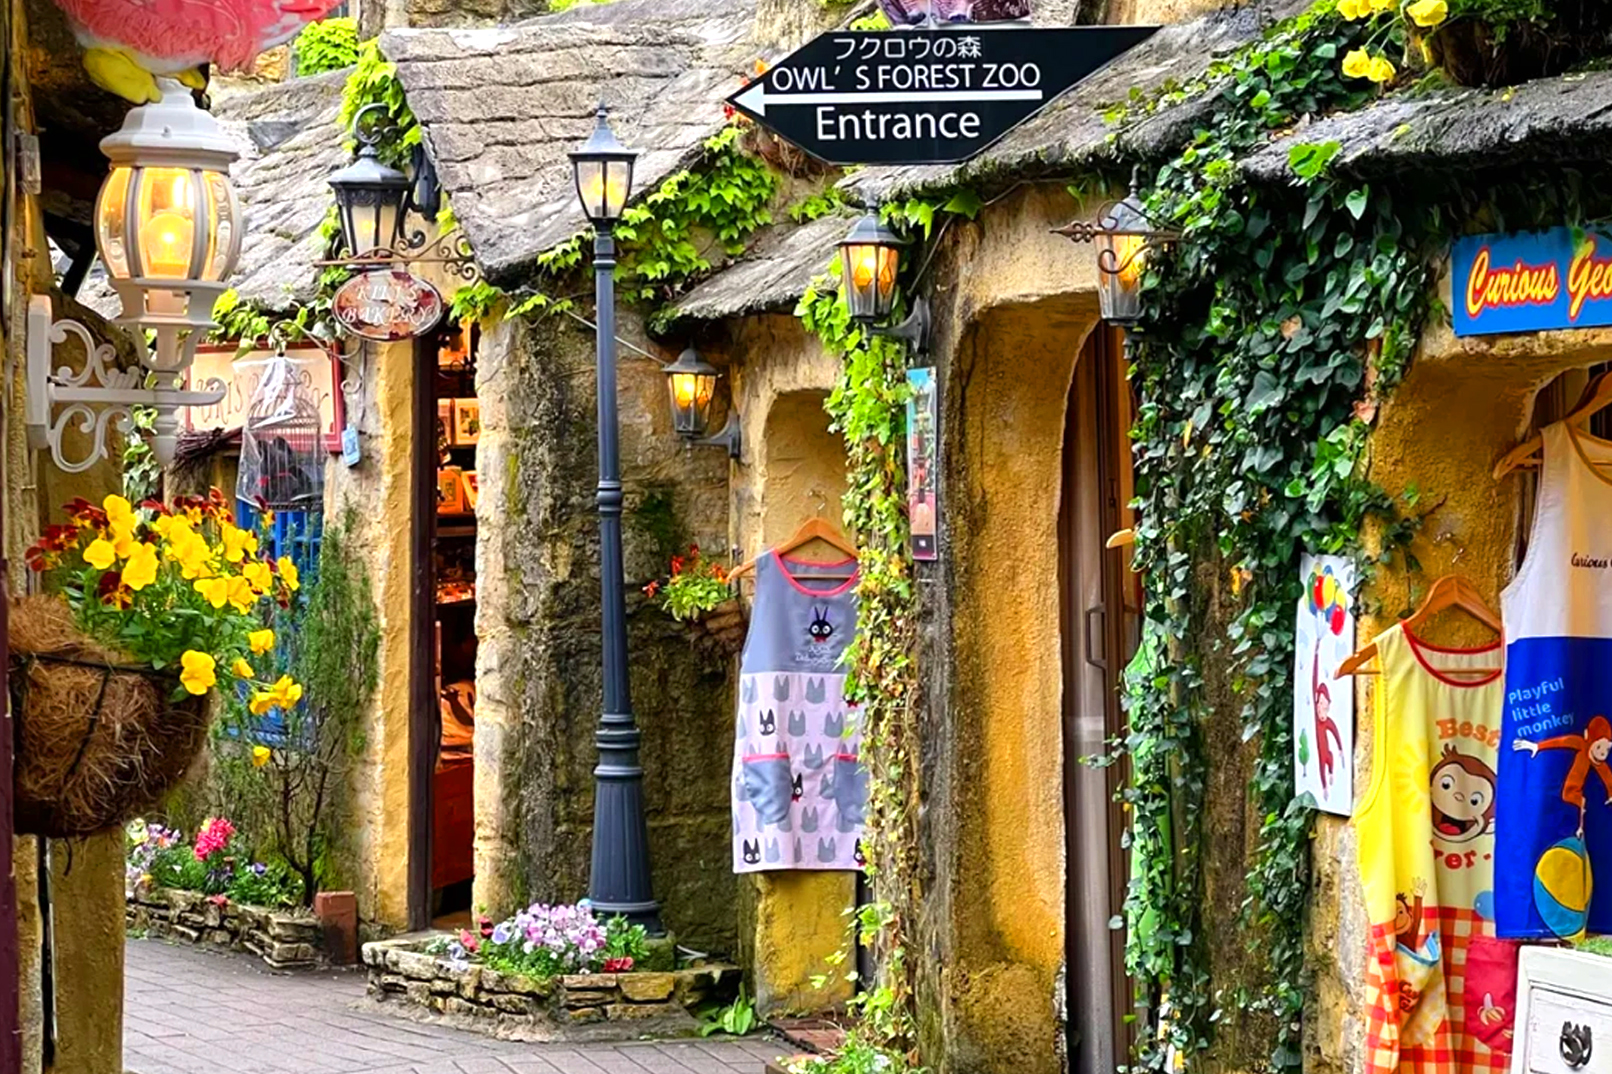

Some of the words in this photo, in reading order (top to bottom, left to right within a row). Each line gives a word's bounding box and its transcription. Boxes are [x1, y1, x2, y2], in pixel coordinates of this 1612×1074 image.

[833, 36, 982, 59] フクロウの森
[877, 64, 976, 89] FOREST
[982, 63, 1041, 87] ZOO
[816, 106, 981, 140] Entrance
[1465, 248, 1560, 316] Curious
[341, 304, 435, 326] BAKERY
[1512, 703, 1551, 722] little
[1517, 712, 1574, 738] monkey
[1436, 718, 1501, 748] Best
